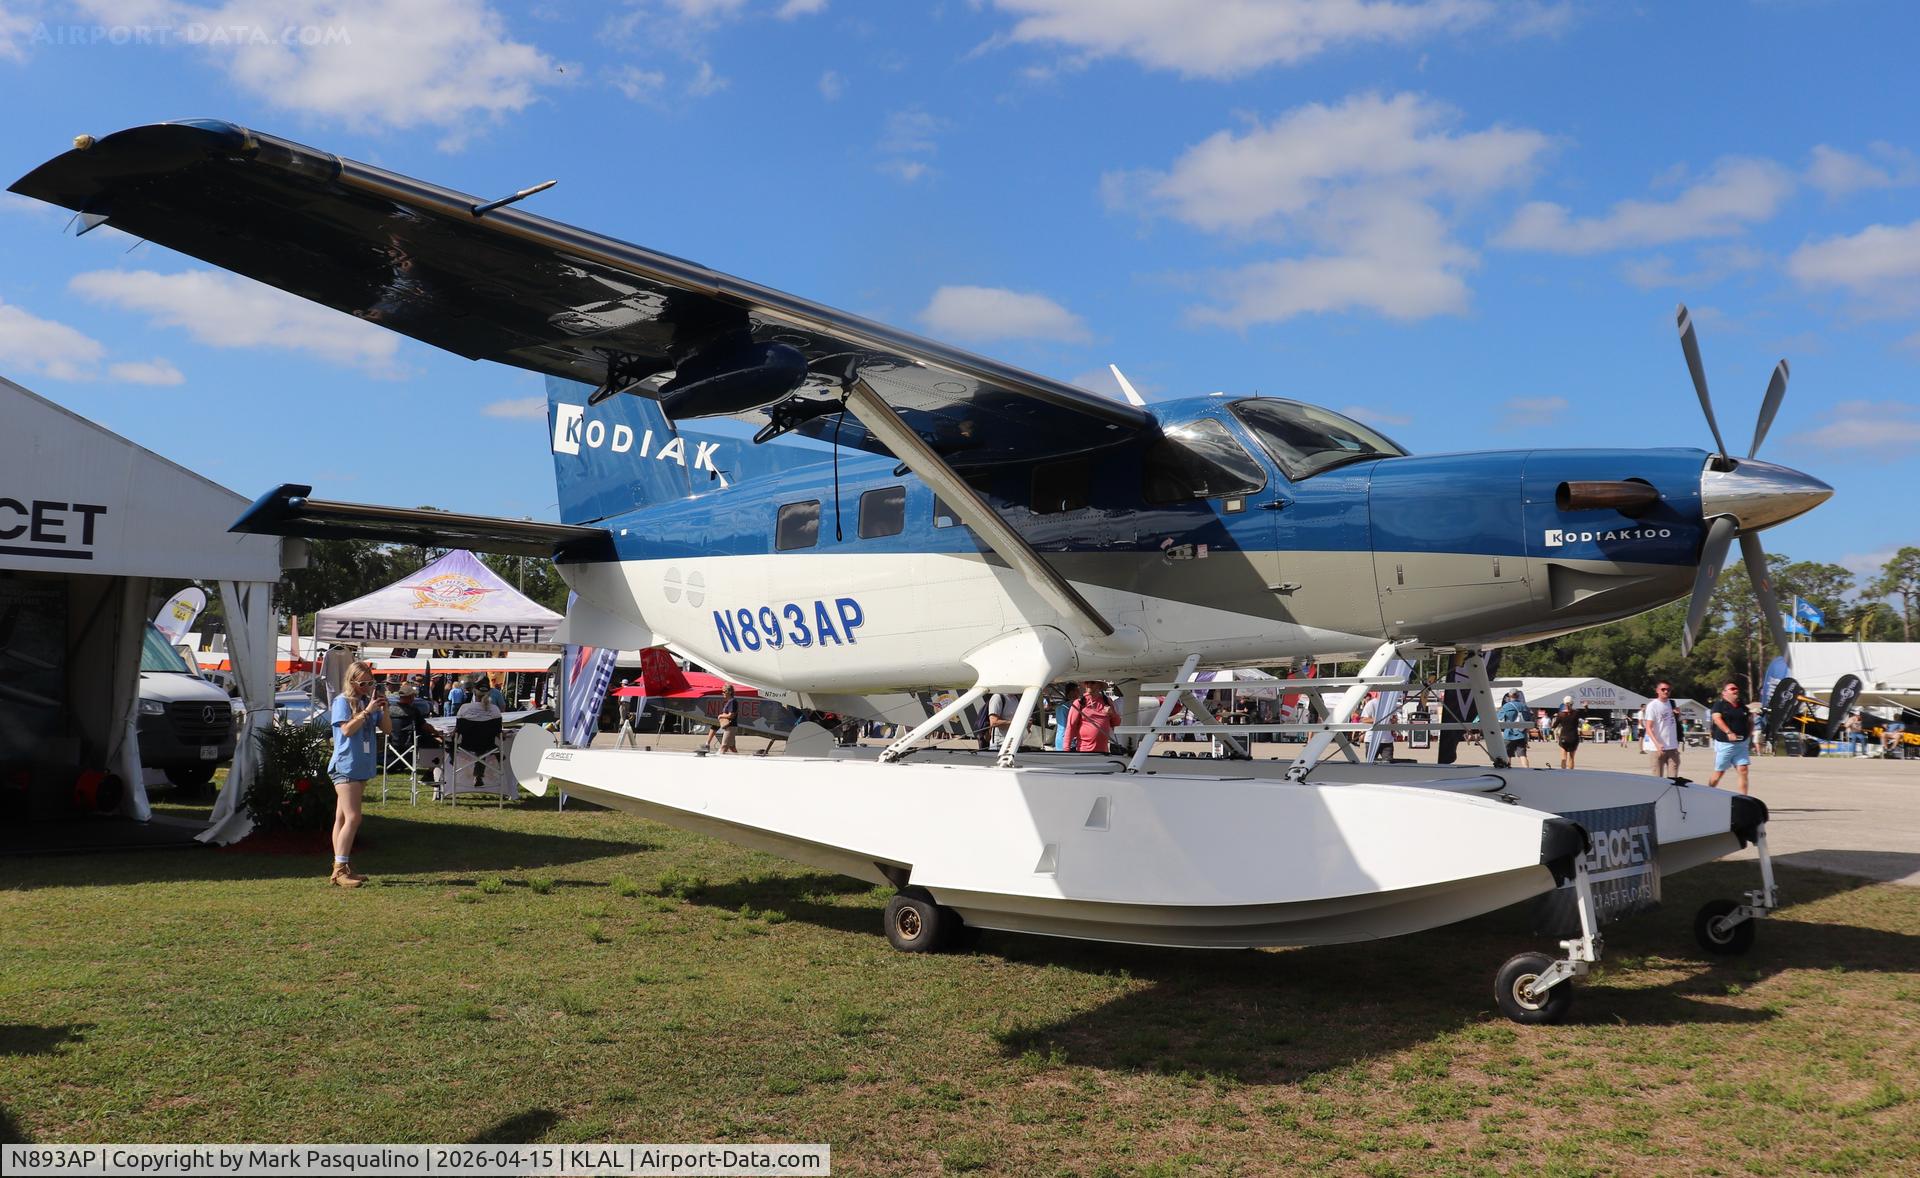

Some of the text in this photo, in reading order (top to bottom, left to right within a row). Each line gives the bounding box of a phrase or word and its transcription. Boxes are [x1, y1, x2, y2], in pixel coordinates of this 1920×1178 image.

[562, 413, 720, 472] KODIAK
[1550, 529, 1671, 543] KODIAK100
[335, 620, 545, 644] ZENITH AIRCRAFT
[713, 597, 865, 653] N893AP
[574, 649, 618, 737] Zenit
[1586, 825, 1651, 871] EROCET
